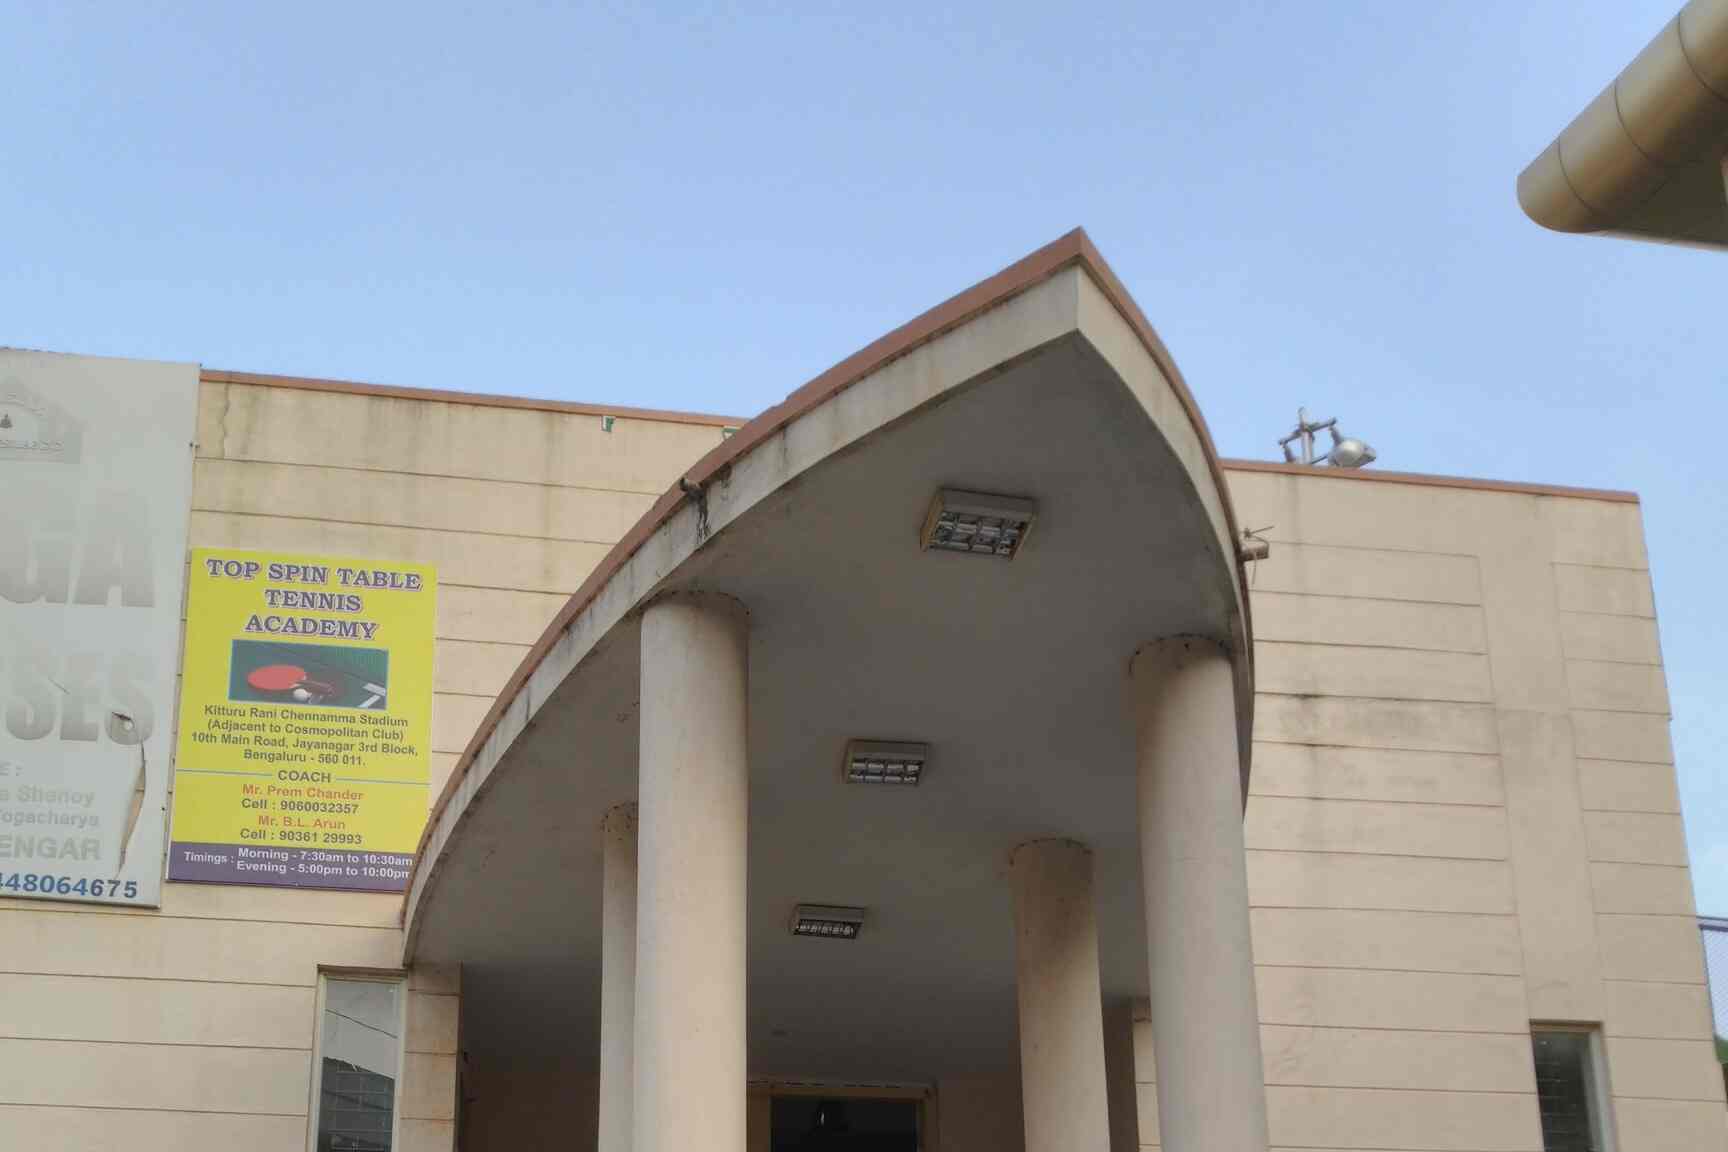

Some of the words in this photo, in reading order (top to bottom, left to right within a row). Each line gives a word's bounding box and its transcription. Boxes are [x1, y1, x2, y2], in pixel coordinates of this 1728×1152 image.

[206, 559, 261, 579] TOP
[268, 563, 329, 585] SPIN
[337, 567, 423, 590] TABLE
[264, 588, 362, 612] TENNIS
[244, 614, 378, 640] ACADEMY
[204, 705, 246, 718] Kitturu
[250, 707, 277, 719] Rani
[280, 709, 355, 724] Chennamma
[359, 715, 408, 727] Stadium
[207, 718, 265, 734] (Adjacent
[269, 723, 281, 733] to
[285, 723, 369, 739] Cosmopolitan
[372, 727, 404, 741] Club)
[192, 731, 217, 743] 10th
[221, 734, 250, 745] Main
[254, 736, 288, 749] Road,
[292, 737, 355, 753] Jayanagar
[358, 742, 377, 753] 3rd
[382, 743, 418, 757] Block,
[243, 749, 306, 763] Bengaluru
[317, 754, 339, 765] 560
[277, 770, 331, 783] COACH
[16, 784, 96, 808] Shenoy
[242, 784, 262, 795] Mr.
[267, 785, 303, 797] Prem
[307, 787, 364, 801] Chander
[241, 798, 267, 809] Cell
[258, 815, 279, 826] Mr.
[313, 818, 346, 830] Arun
[240, 828, 266, 840] Cell
[279, 831, 318, 842] 90361
[323, 833, 362, 845] 29993
[0, 834, 104, 861] ENGAR
[184, 851, 228, 864] Timings
[238, 848, 289, 862] Morning
[300, 852, 344, 863] 7:30am
[347, 854, 359, 864] to
[362, 854, 412, 866] 10:30am
[236, 861, 287, 874] Evening
[297, 864, 343, 877] 5:00pm
[346, 867, 358, 877] to
